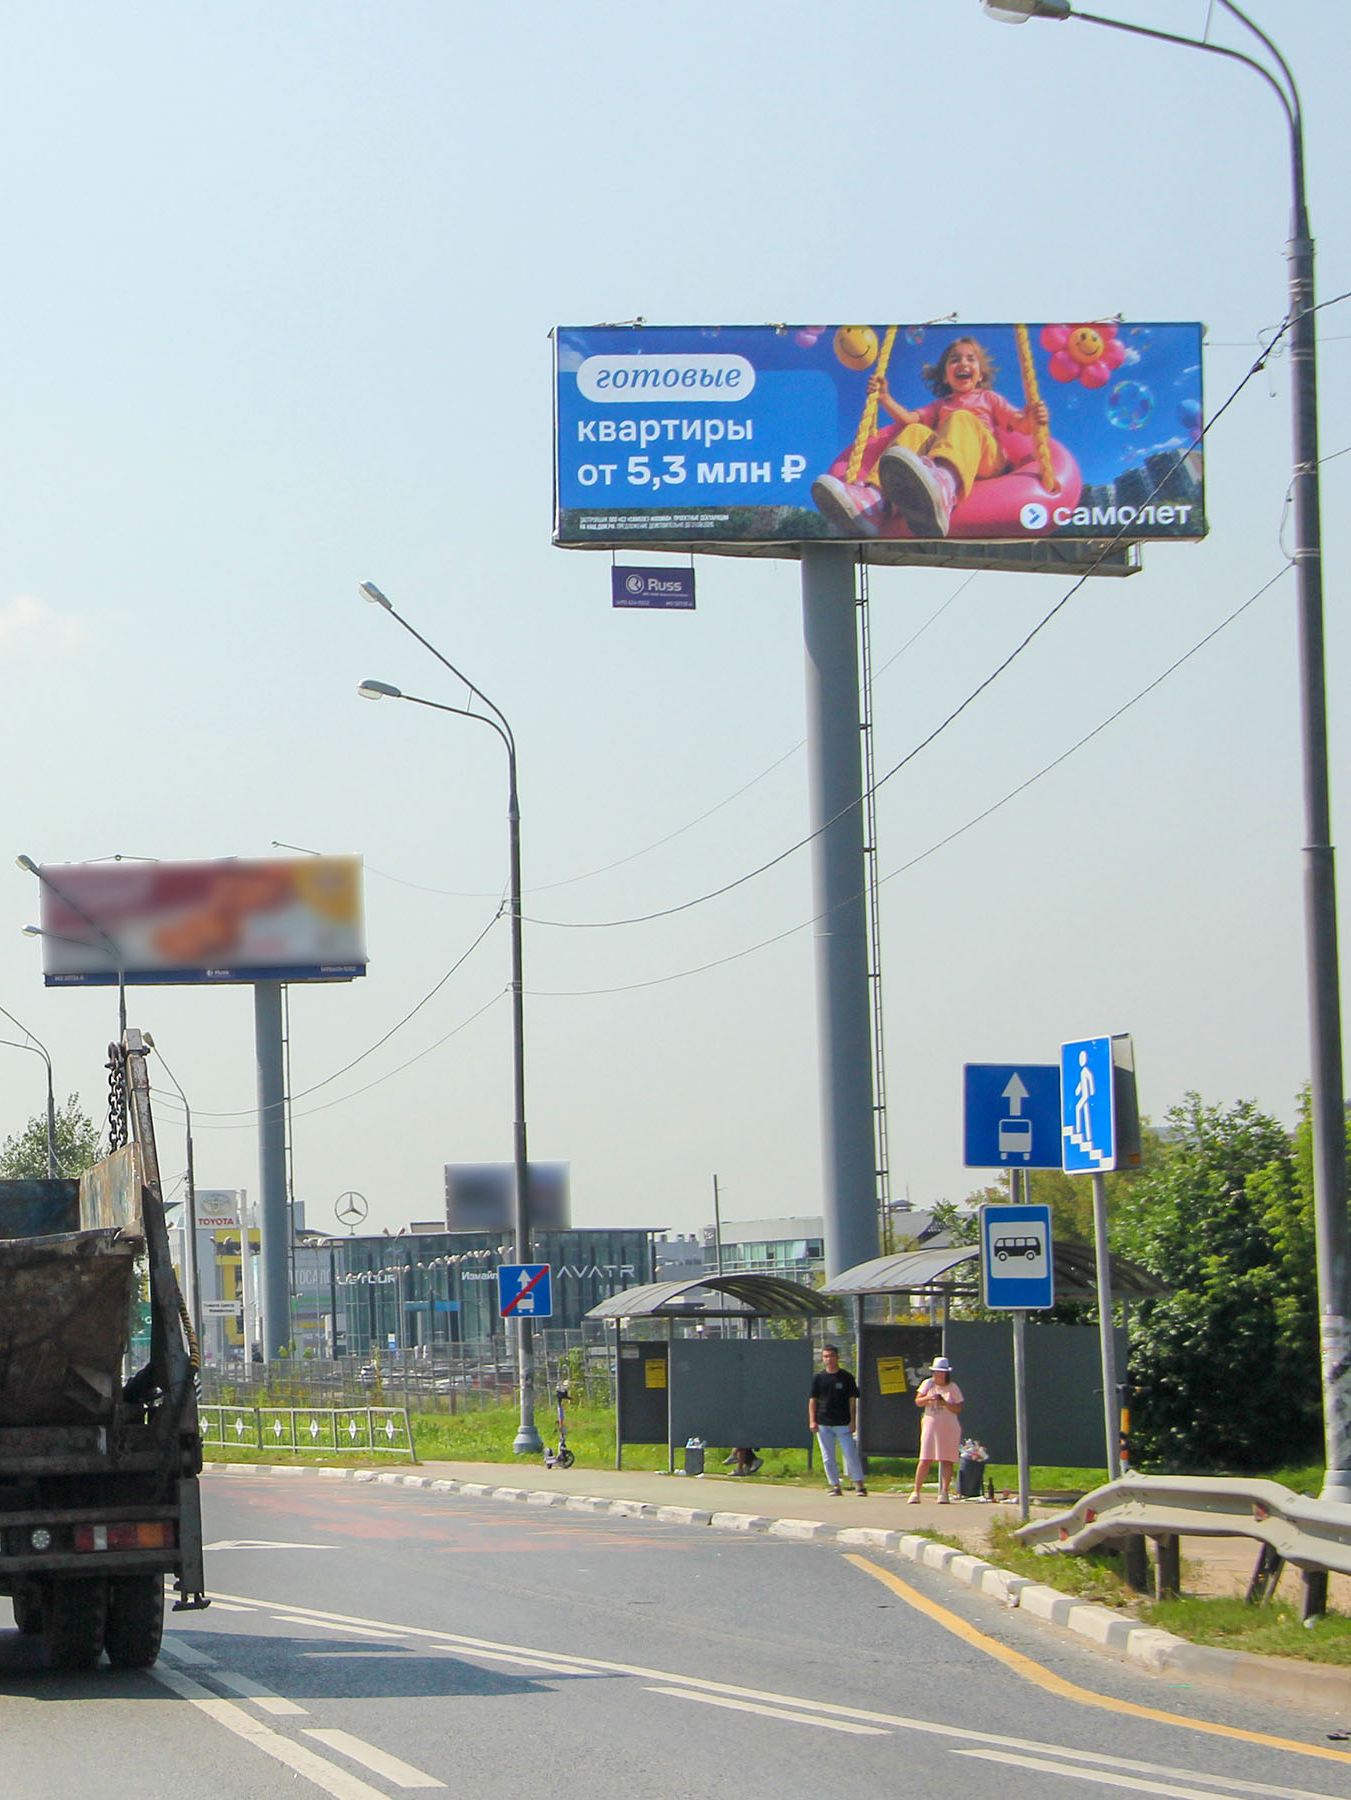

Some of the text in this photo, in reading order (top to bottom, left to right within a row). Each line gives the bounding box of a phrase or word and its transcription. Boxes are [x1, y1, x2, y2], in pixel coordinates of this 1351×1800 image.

[596, 368, 742, 389] готовые
[577, 418, 753, 448] квартиры
[577, 463, 618, 486] от
[627, 455, 687, 490] 5,3
[697, 461, 772, 484] млн
[1053, 505, 1193, 526] самолет
[647, 578, 683, 592] Russ
[198, 1217, 234, 1226] TOYOTA
[461, 1270, 499, 1281] Измайл
[556, 1264, 636, 1280] AVATR
